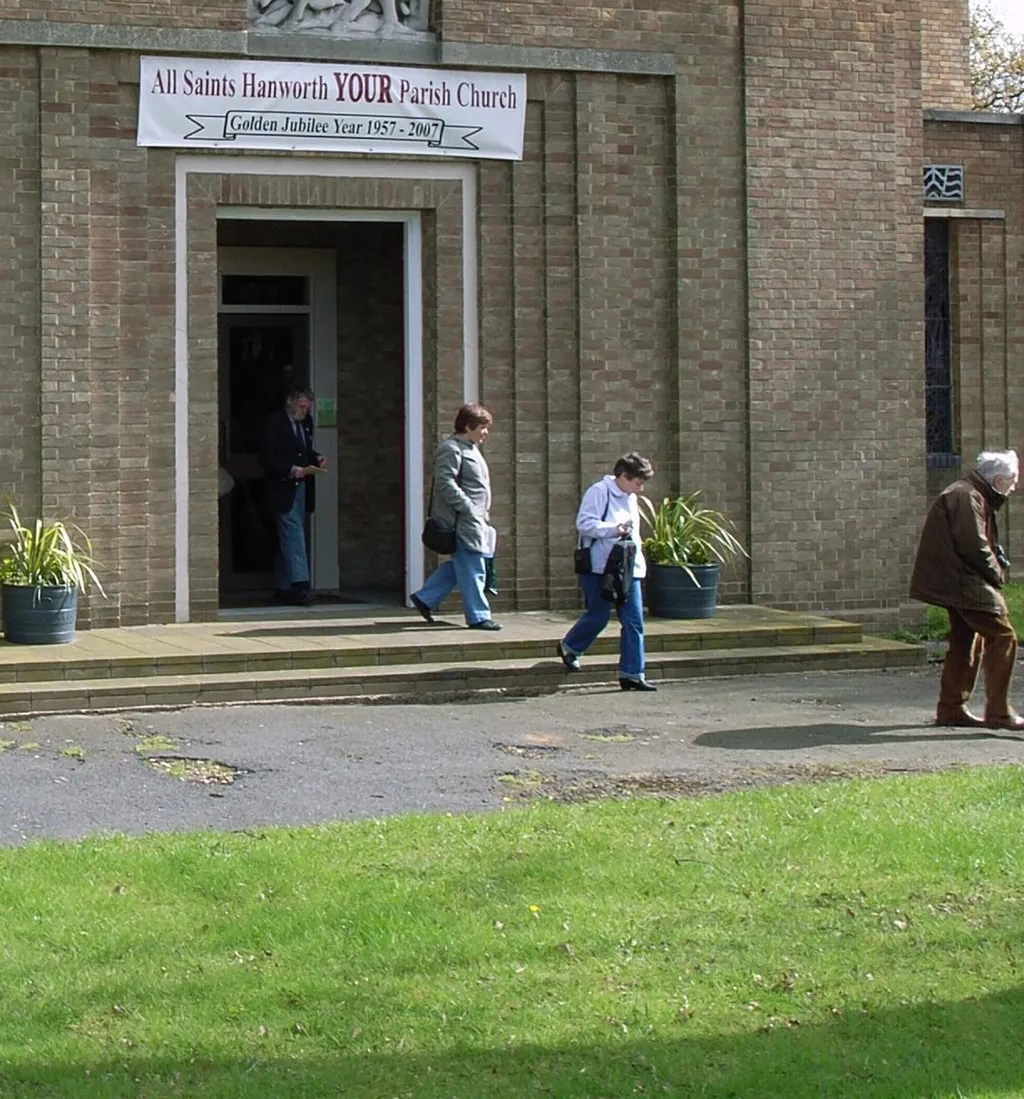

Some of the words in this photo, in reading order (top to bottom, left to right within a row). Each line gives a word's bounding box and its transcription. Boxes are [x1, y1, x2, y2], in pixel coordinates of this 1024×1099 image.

[151, 68, 177, 95] All
[183, 69, 236, 98] Saints
[242, 72, 328, 100] Hanworth
[333, 71, 393, 104] YOUR
[399, 79, 451, 107] Parish
[456, 82, 517, 109] Church
[230, 114, 277, 132] Golden
[280, 116, 329, 134] Jubilee
[333, 118, 363, 135] Year
[366, 119, 397, 135] 1957
[408, 122, 439, 139] 2007
